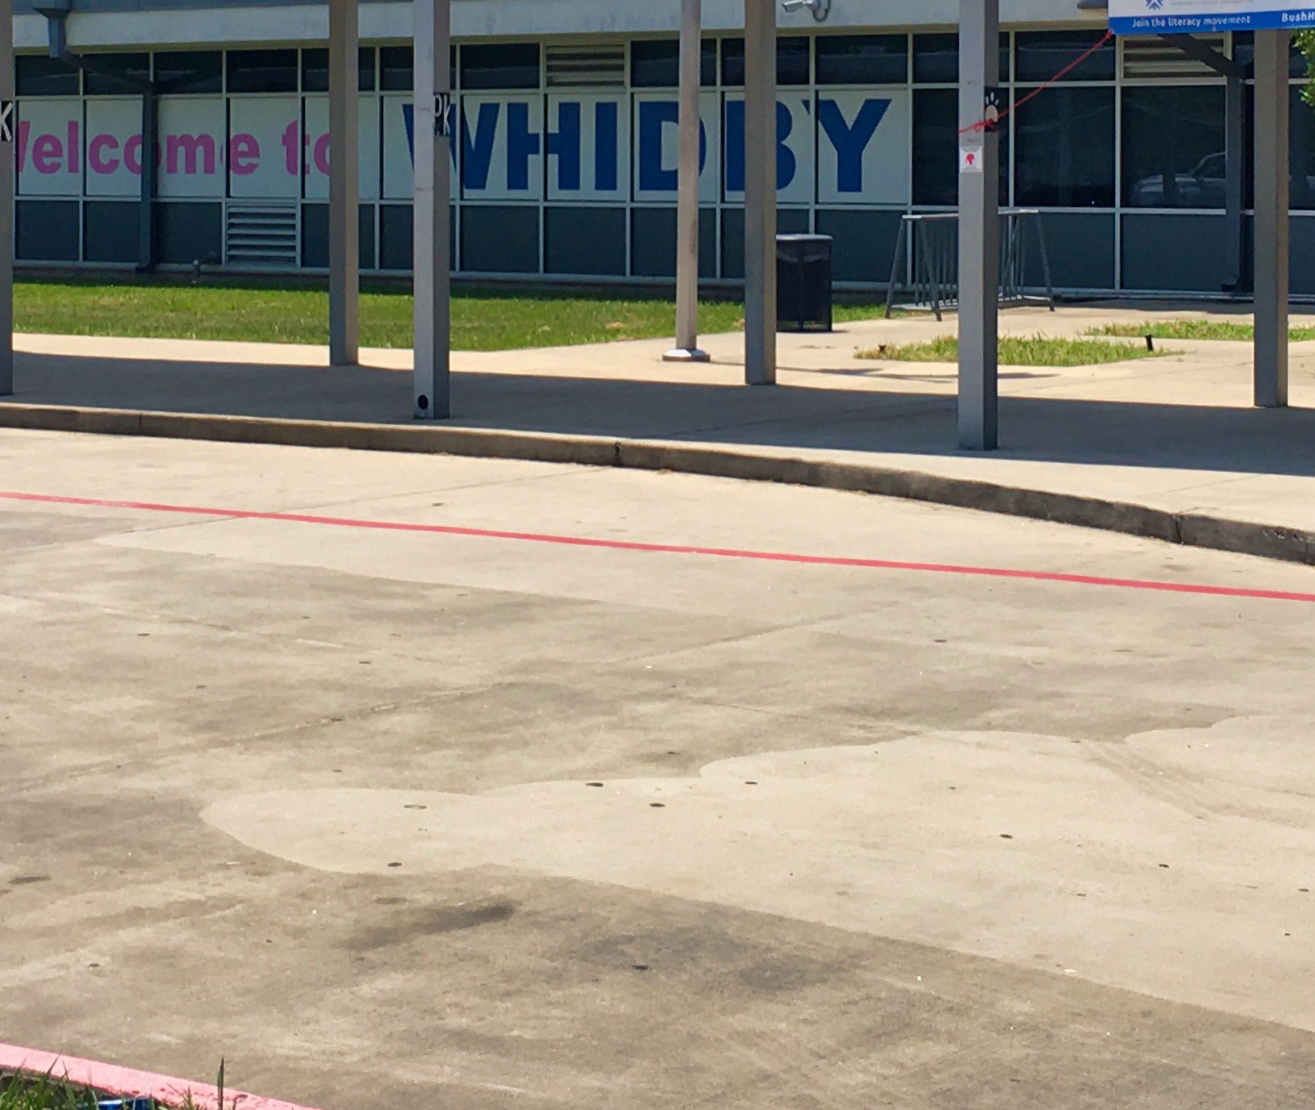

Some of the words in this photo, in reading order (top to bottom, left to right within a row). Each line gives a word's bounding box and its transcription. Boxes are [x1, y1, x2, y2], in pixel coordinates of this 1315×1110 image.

[1131, 19, 1150, 29] Join
[1151, 18, 1166, 27] the
[1167, 17, 1202, 28] literacy
[1203, 15, 1252, 26] movement
[401, 98, 894, 193] WHIDBY
